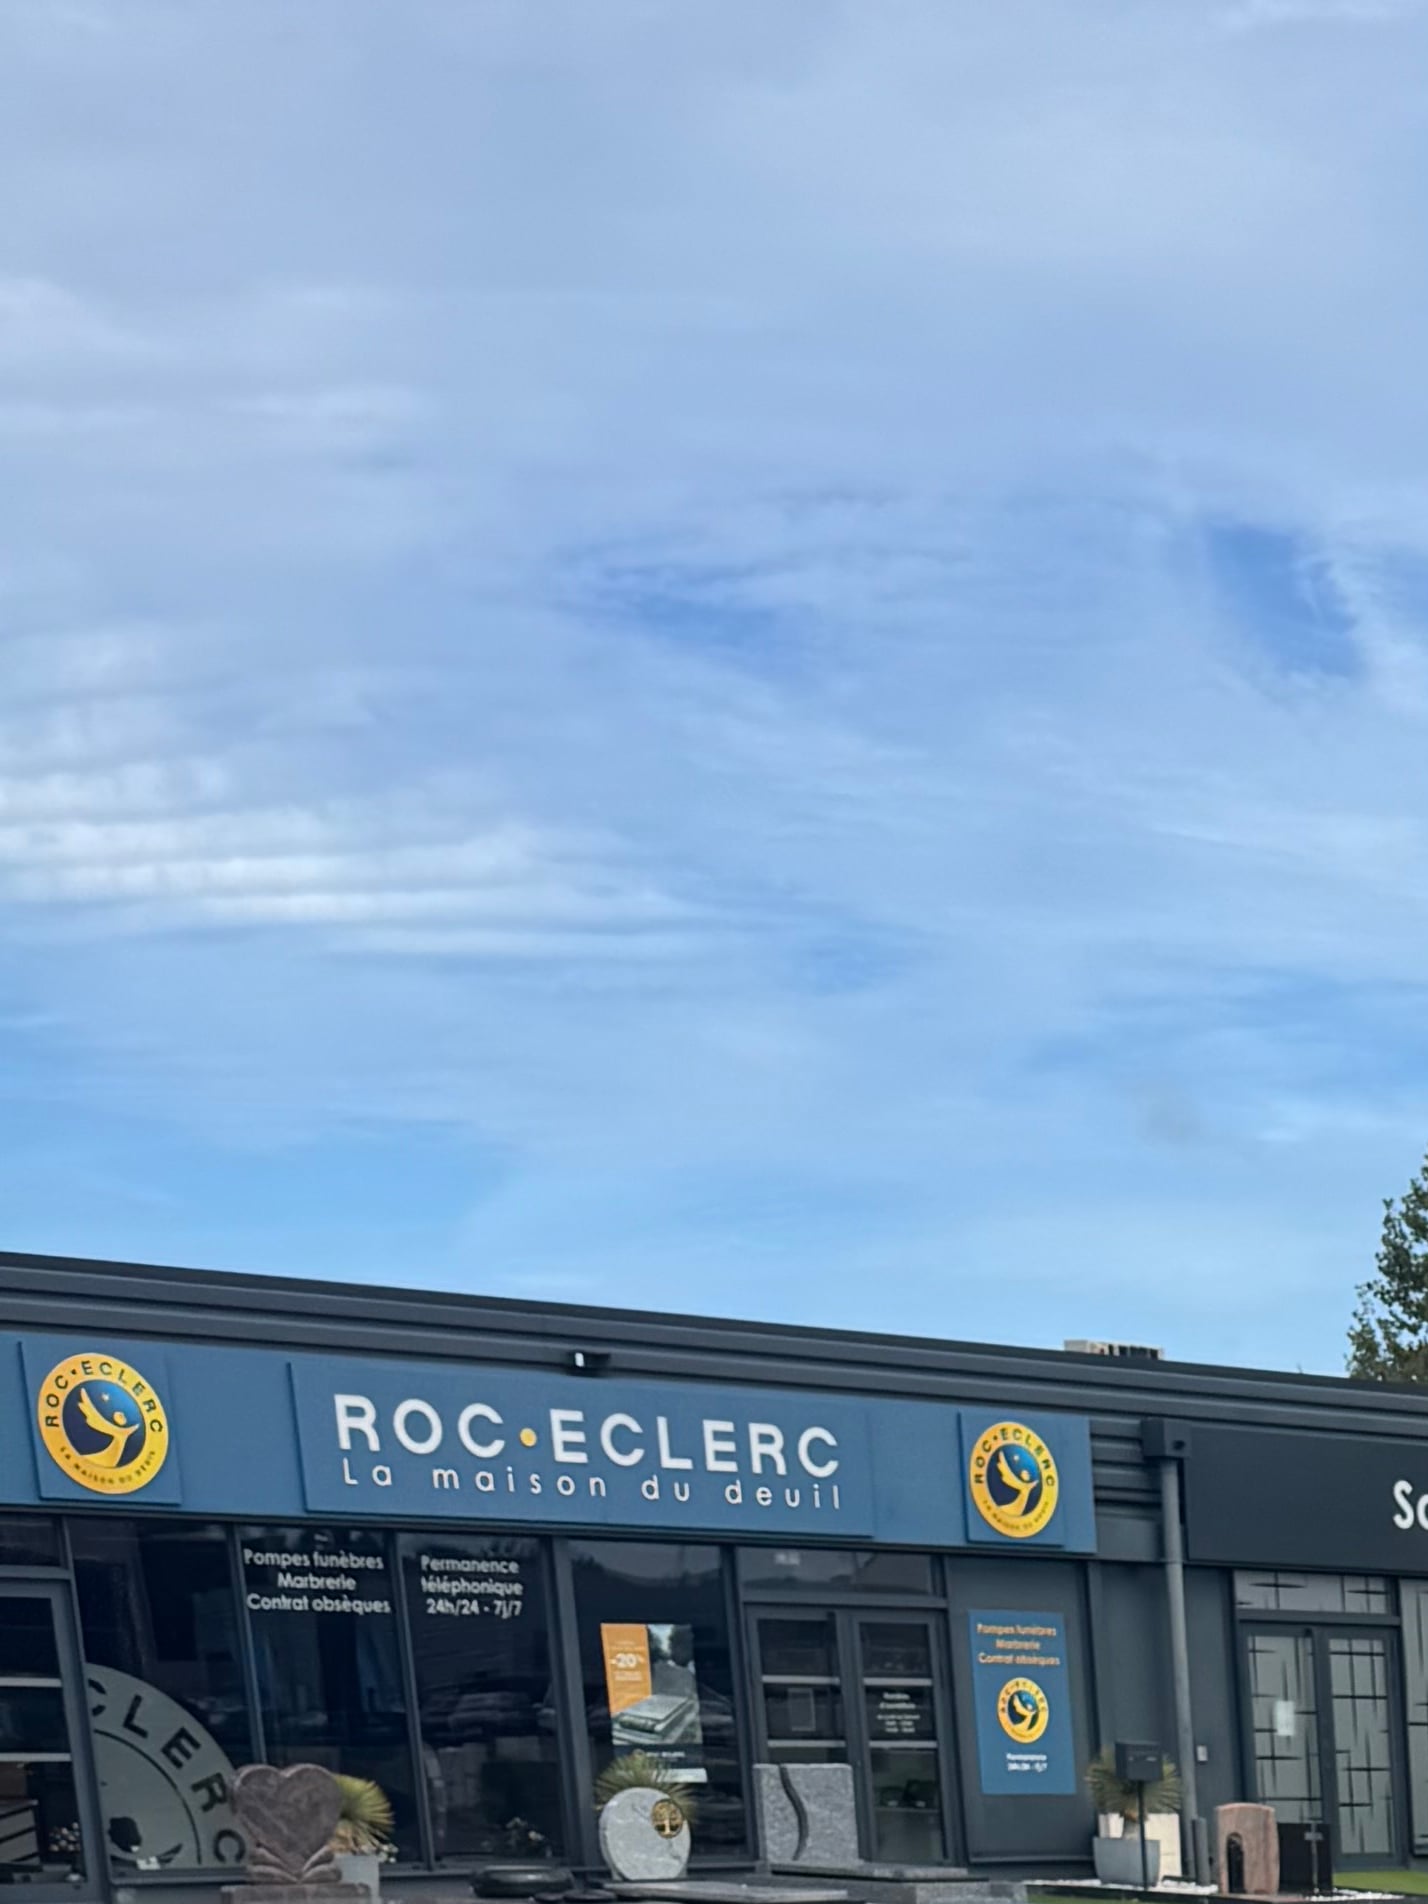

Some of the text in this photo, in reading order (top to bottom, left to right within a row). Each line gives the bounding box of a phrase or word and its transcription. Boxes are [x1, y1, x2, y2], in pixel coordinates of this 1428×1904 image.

[342, 1458, 839, 1509] La maison du deuil
[243, 1548, 384, 1570] Pompes funèbres
[421, 1554, 520, 1574] Permanence
[277, 1572, 357, 1591] Marbrerie
[421, 1575, 523, 1597] téléphonique
[246, 1593, 391, 1616] Contrat obsèques
[426, 1598, 480, 1616] 24h/24
[493, 1599, 523, 1619] 7j/7
